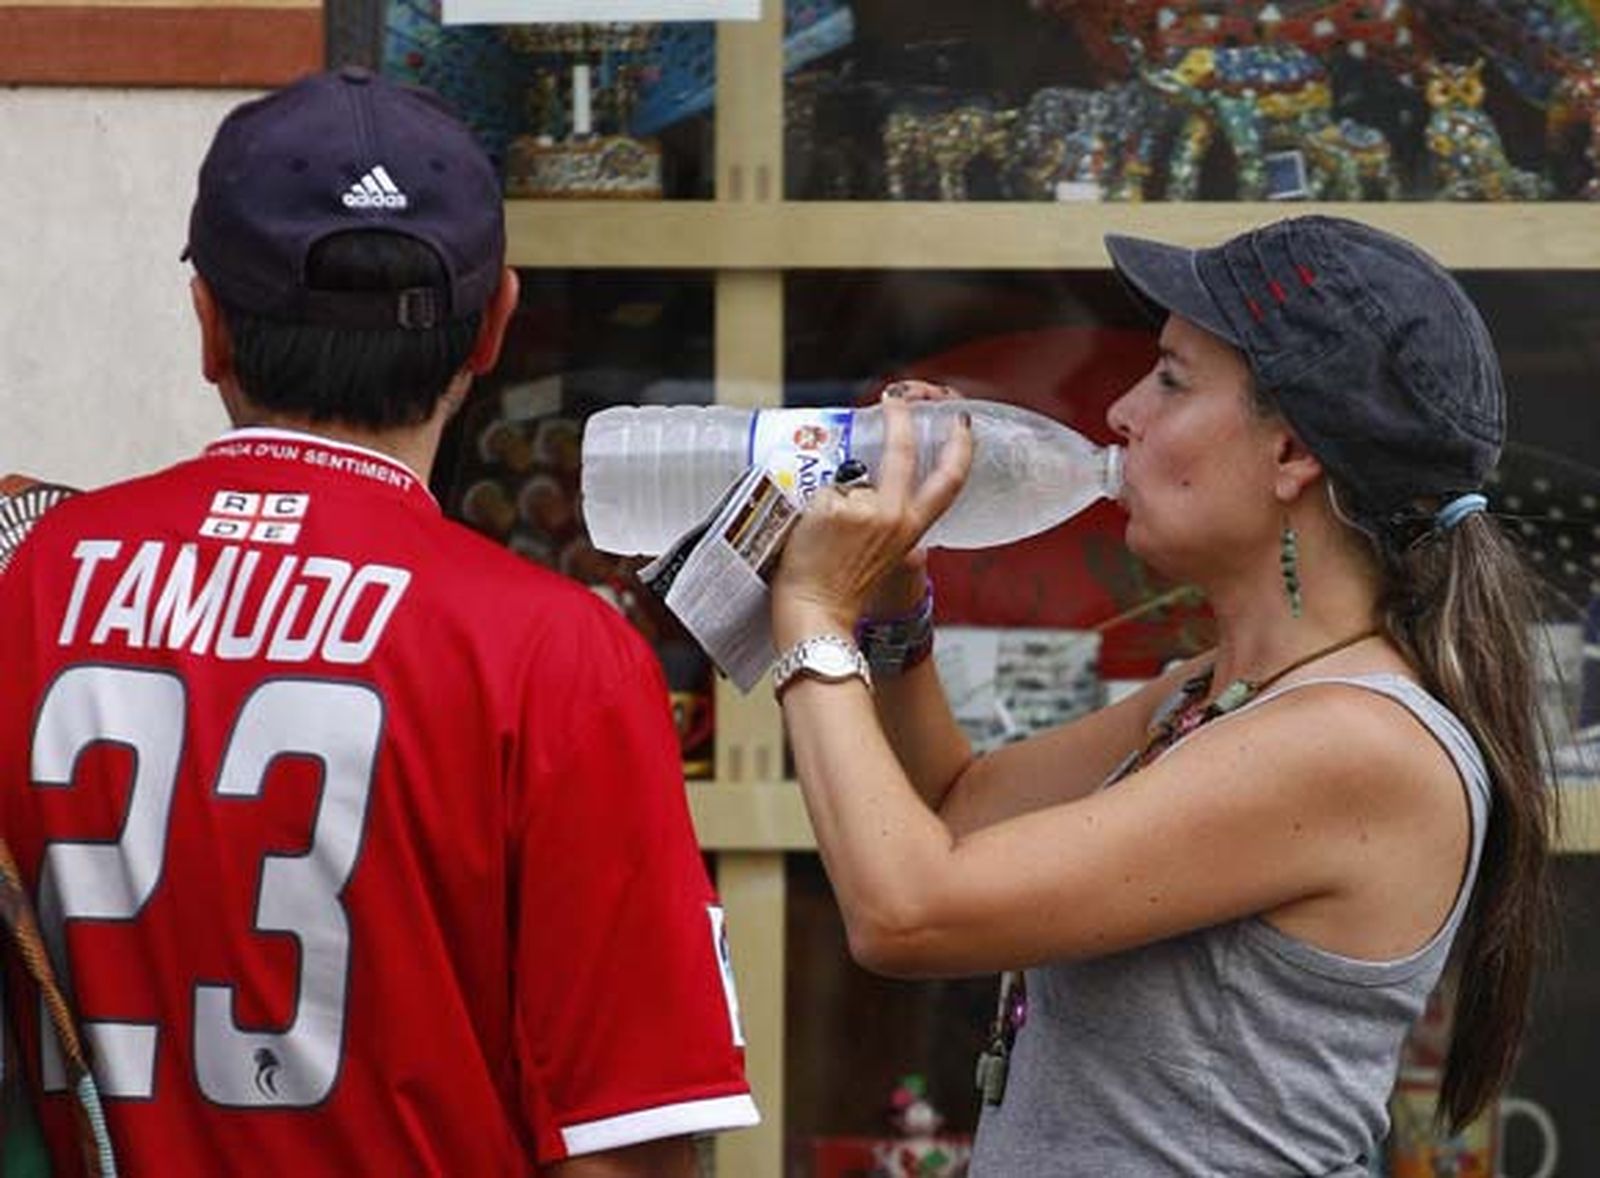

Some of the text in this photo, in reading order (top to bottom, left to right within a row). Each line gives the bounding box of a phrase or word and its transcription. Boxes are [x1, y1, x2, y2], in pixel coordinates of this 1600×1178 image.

[342, 190, 407, 208] adidas
[254, 443, 299, 460] D'UN
[303, 450, 413, 491] SENTIMENT
[57, 540, 413, 663] TAMUDO
[30, 664, 384, 1109] 23
